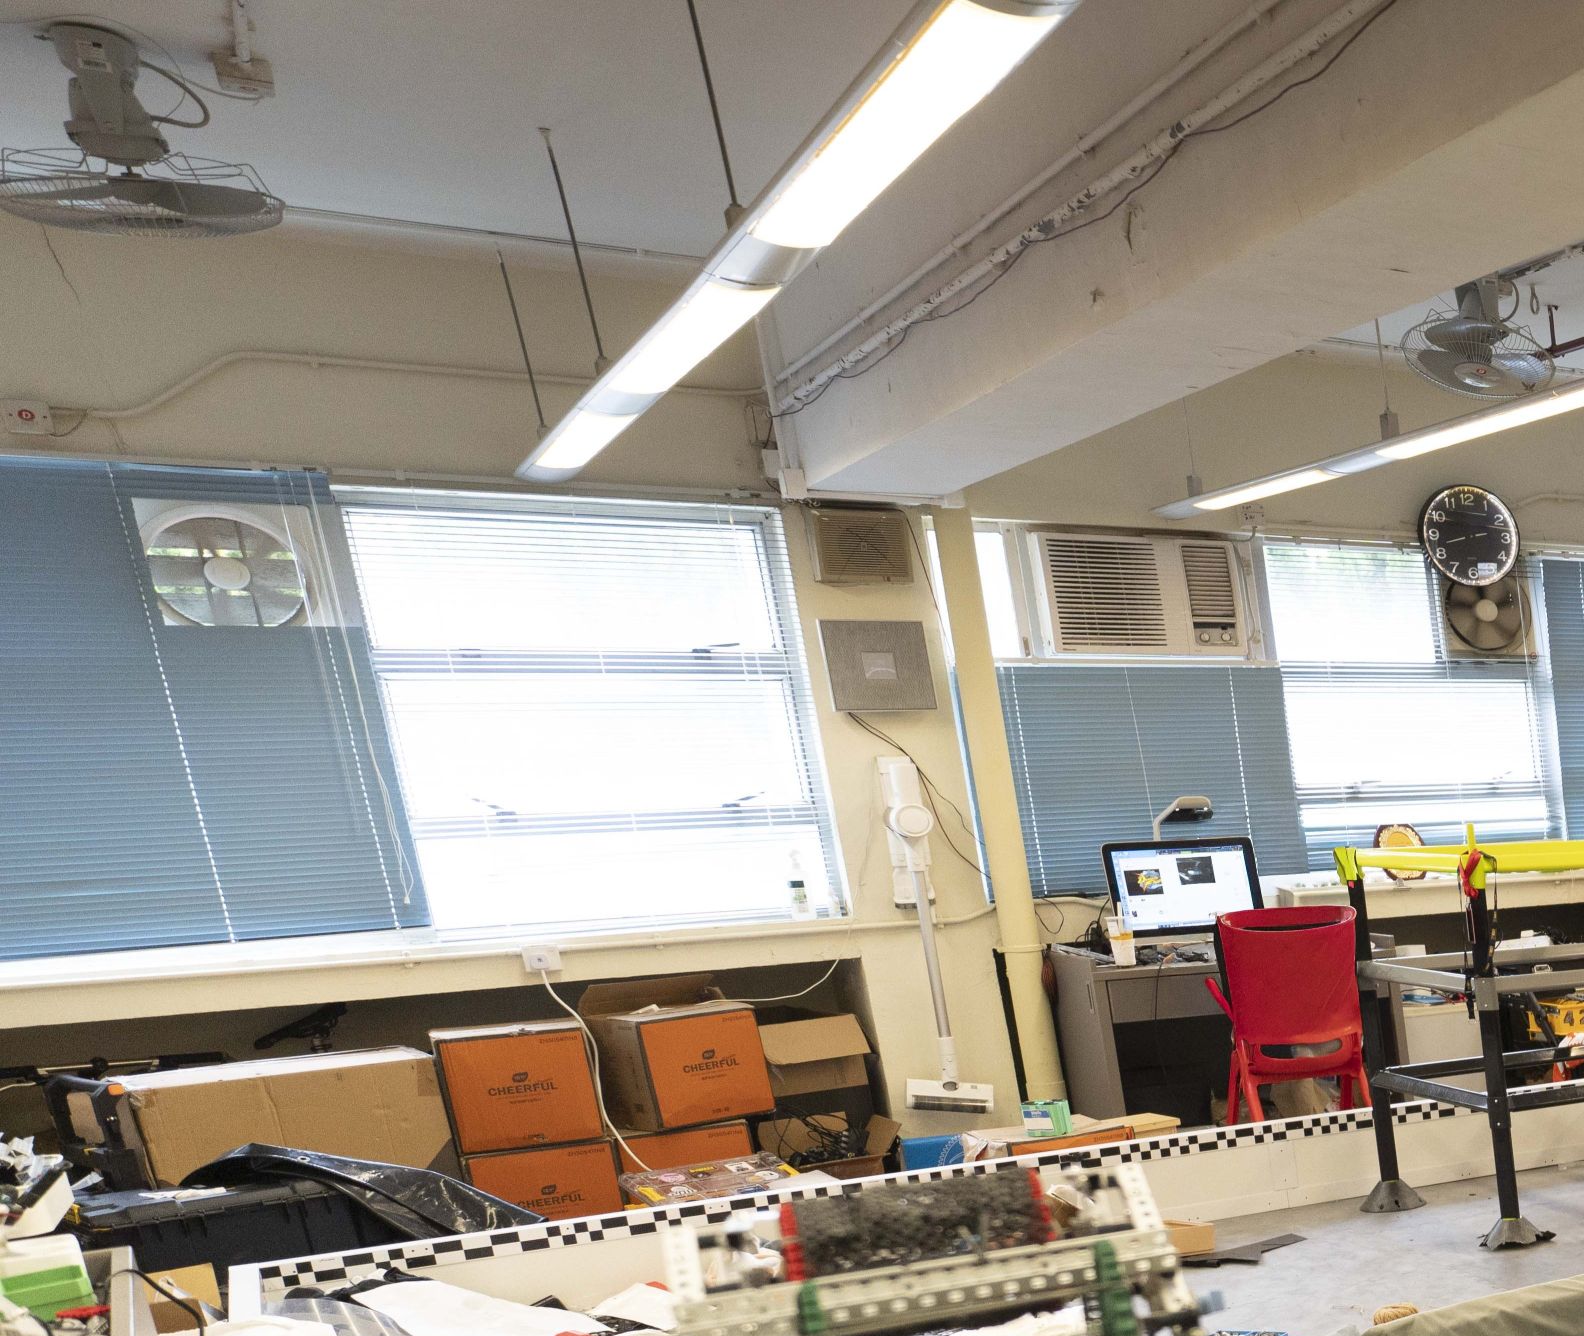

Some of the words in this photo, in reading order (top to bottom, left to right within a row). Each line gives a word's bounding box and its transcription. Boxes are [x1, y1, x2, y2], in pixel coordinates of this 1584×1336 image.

[1444, 497, 1456, 509] 11
[1460, 494, 1475, 506] 12
[1483, 500, 1488, 512] 1
[1431, 511, 1446, 523] 10
[1494, 514, 1504, 526] 2
[1429, 529, 1439, 541] 9
[1501, 532, 1511, 544] 3
[1436, 547, 1446, 559] 8
[1498, 551, 1507, 561] 4
[1450, 562, 1459, 574] 7
[1468, 567, 1479, 579] 6
[683, 1058, 740, 1074] CHEERFUL
[488, 1081, 558, 1097] CHEERFUL
